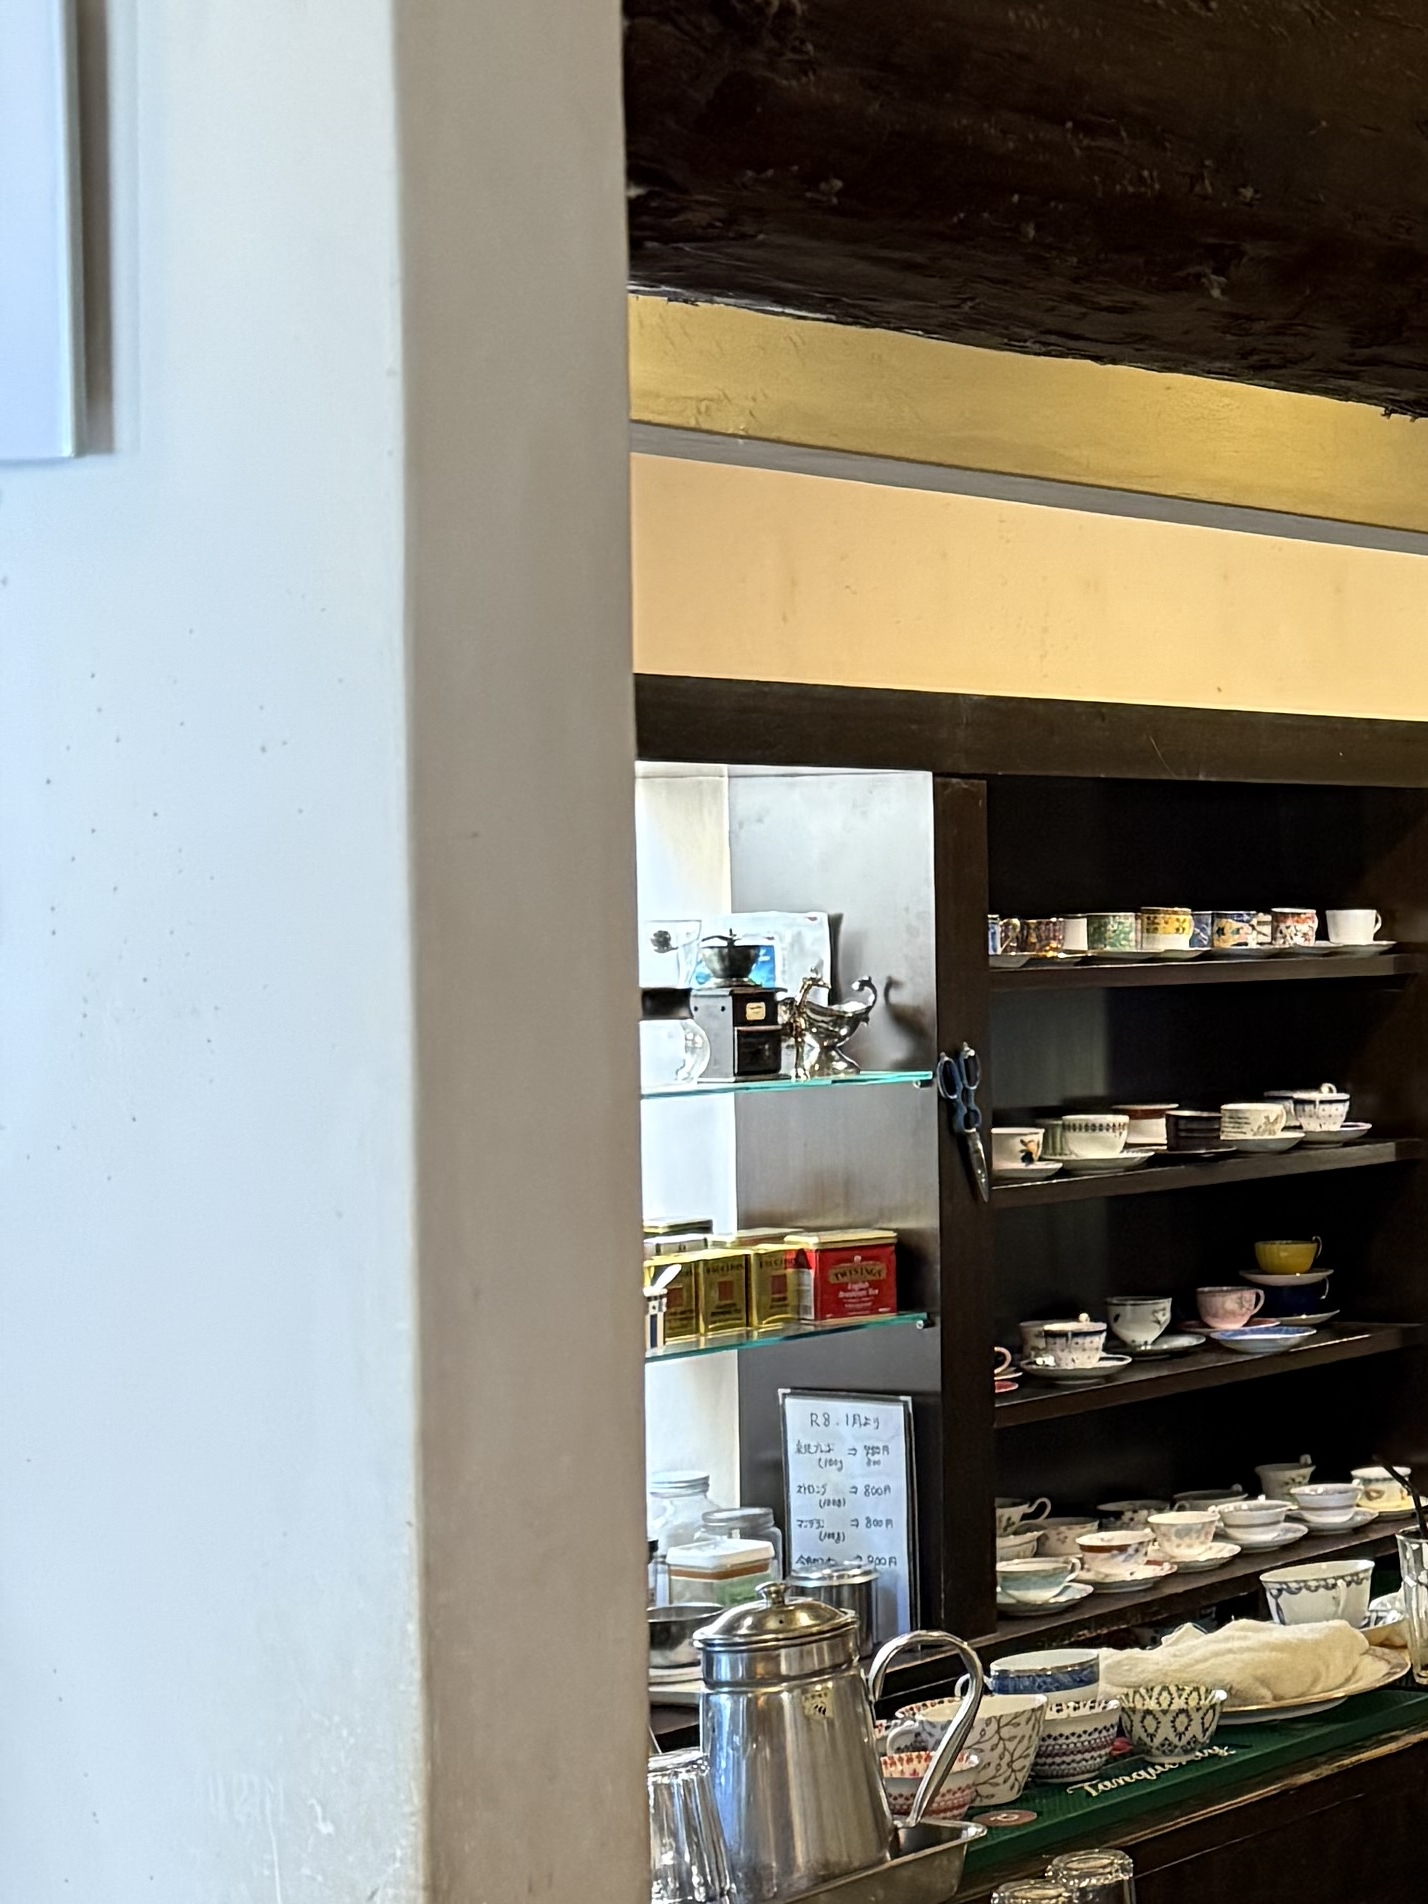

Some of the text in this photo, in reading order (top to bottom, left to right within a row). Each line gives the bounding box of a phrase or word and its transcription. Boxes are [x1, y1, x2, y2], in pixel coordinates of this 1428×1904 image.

[863, 1483, 892, 1497] 800円
[865, 1516, 894, 1529] 800円
[1066, 1745, 1237, 1797] Tanqueay
